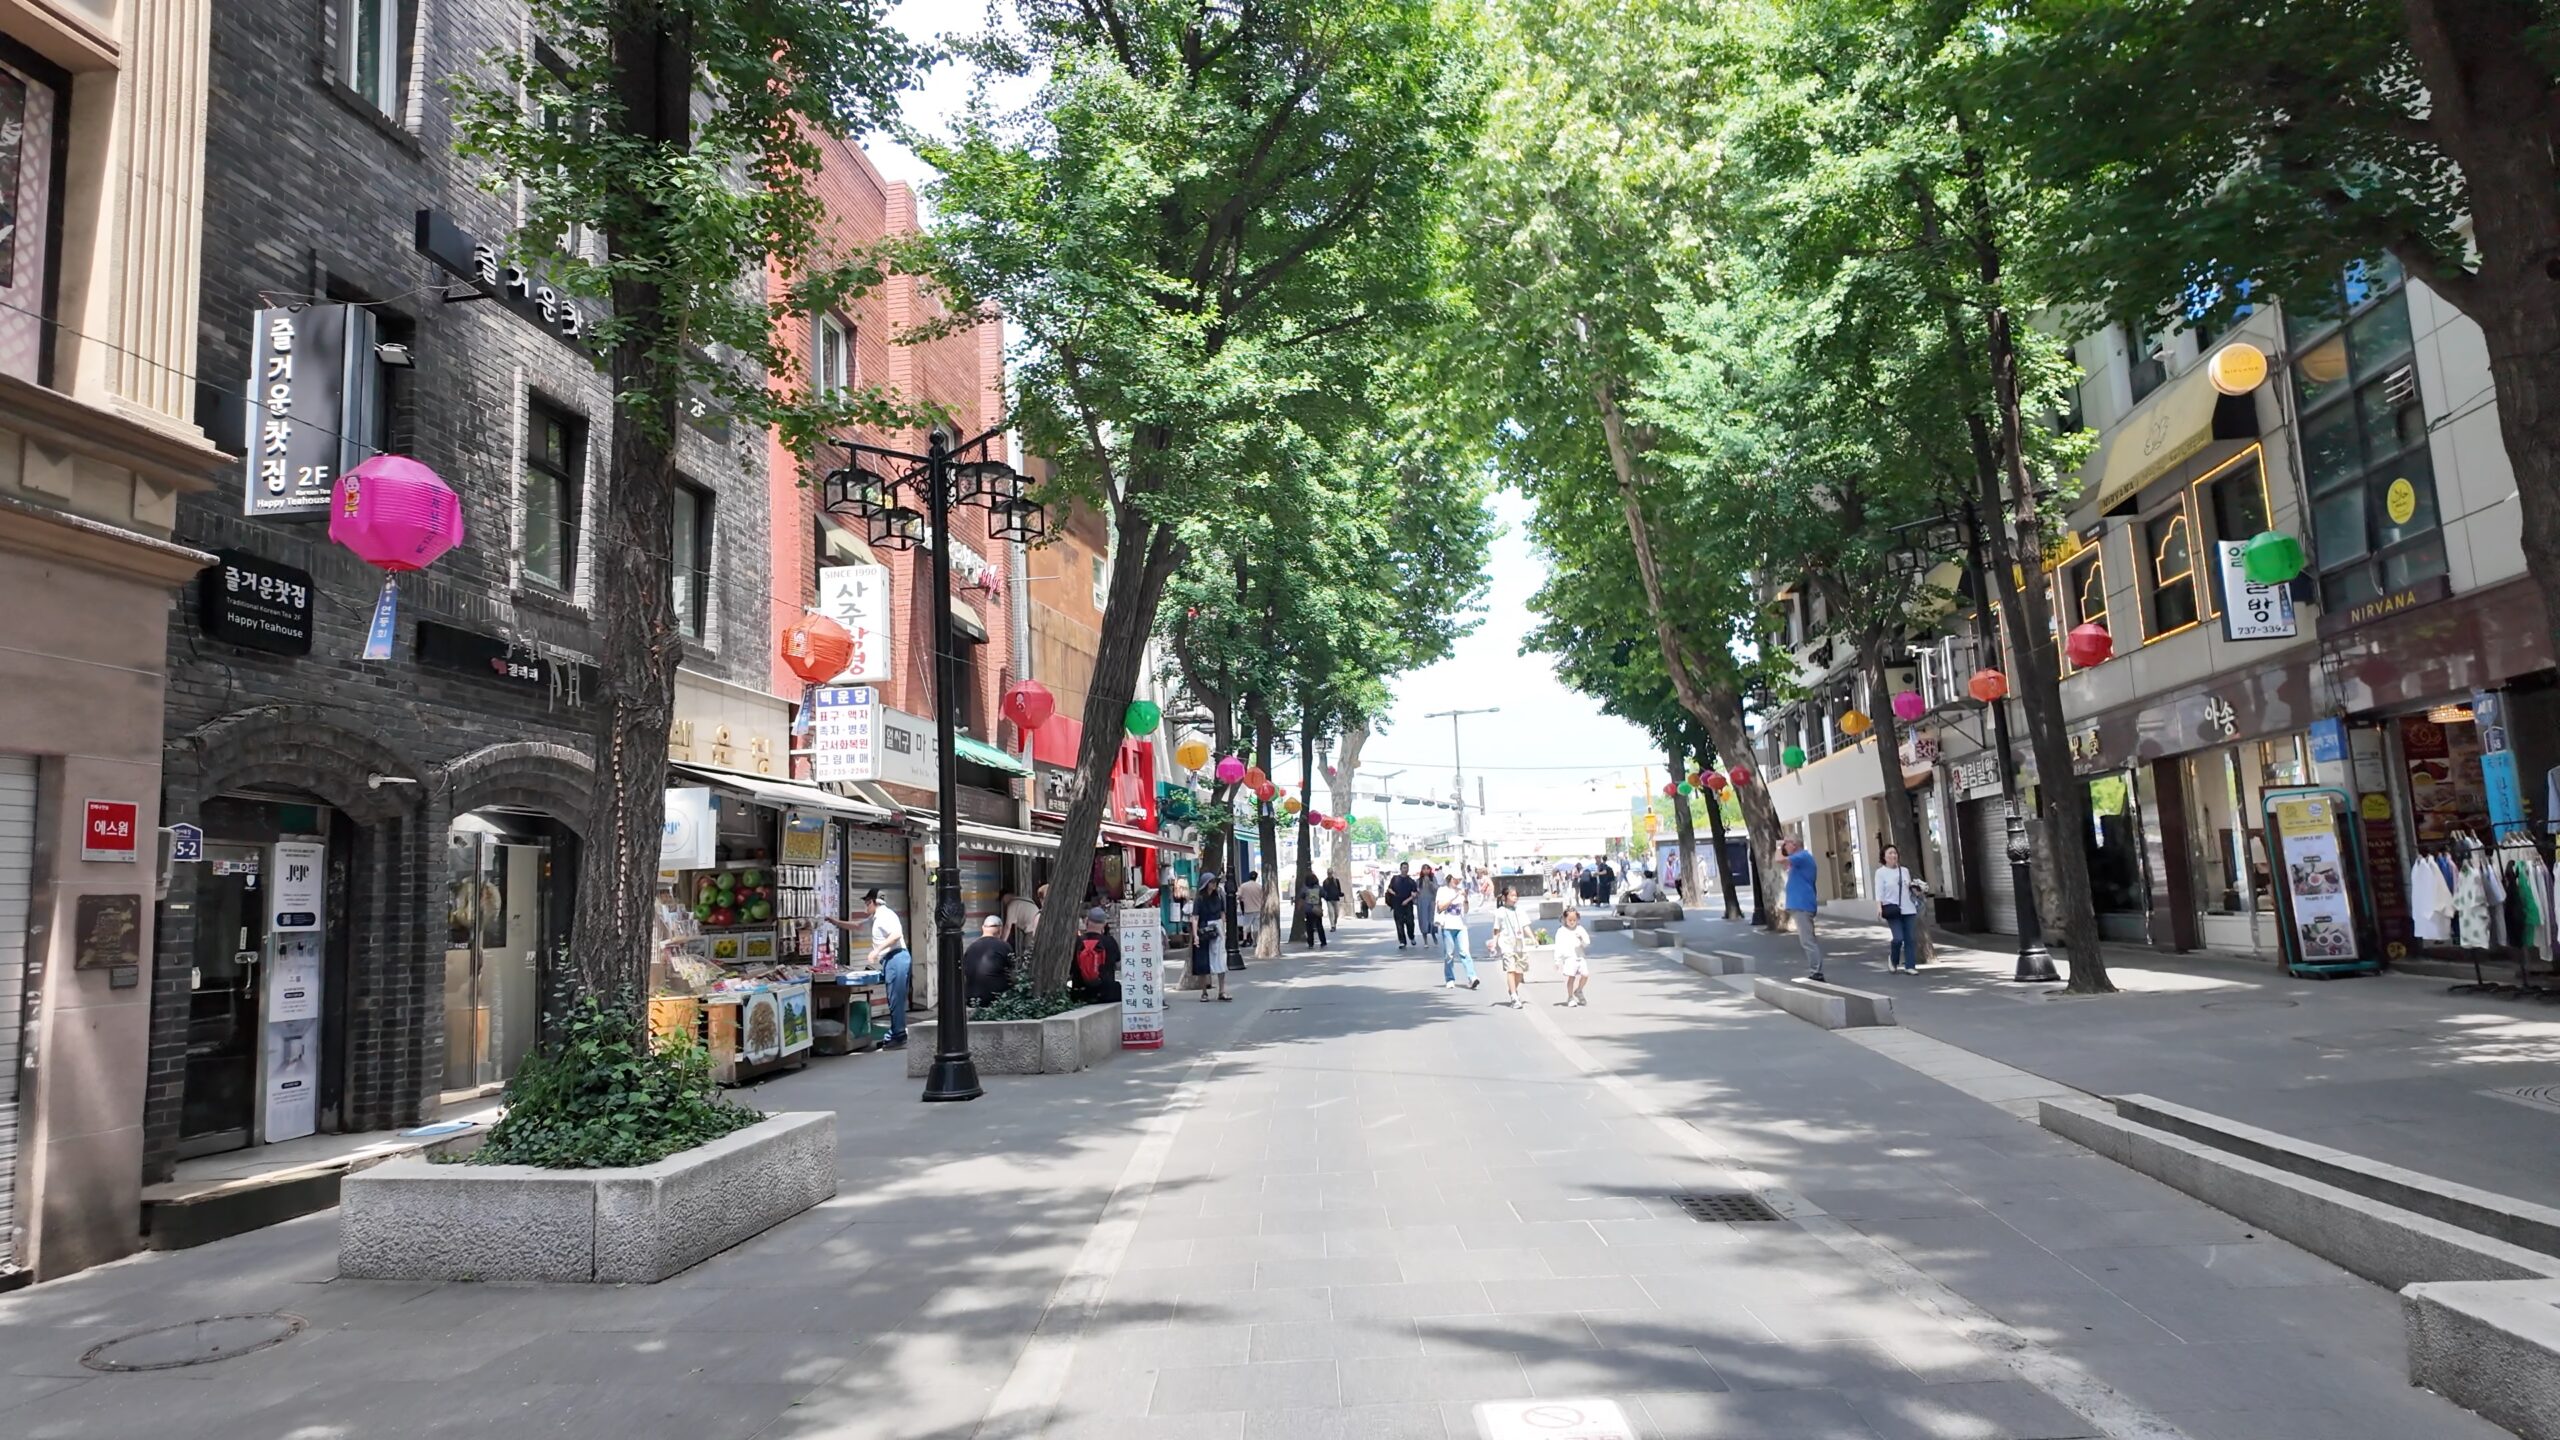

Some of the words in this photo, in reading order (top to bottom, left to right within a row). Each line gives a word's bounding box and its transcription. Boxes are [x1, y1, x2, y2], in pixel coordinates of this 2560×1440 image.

[474, 243, 606, 357] 즐거운찻
[261, 317, 295, 493] 즐거운찻집
[298, 466, 328, 486] 2F
[295, 489, 319, 497] Korean
[257, 498, 285, 510] Happy
[287, 495, 331, 506] Teahouse
[825, 570, 851, 579] SINCE
[855, 568, 878, 576] 1990
[225, 566, 305, 608] 즐거운찻집
[227, 597, 259, 611] Traditional
[260, 606, 281, 616] Korean
[282, 610, 292, 619] Tea
[2351, 591, 2417, 623] NIRVANA
[227, 612, 258, 630] Happy
[260, 619, 304, 639] Teahouse
[820, 690, 867, 705] 백운당
[819, 738, 868, 751] 고서화복원
[886, 727, 910, 754] 얼씨구
[94, 820, 128, 837] 에스원
[1124, 930, 1151, 940] 사주
[1124, 943, 1151, 952] 타로
[1125, 957, 1152, 968] 작명
[1125, 971, 1153, 982] 신점
[1125, 984, 1153, 995] 궁합
[1126, 998, 1154, 1009] 택일
